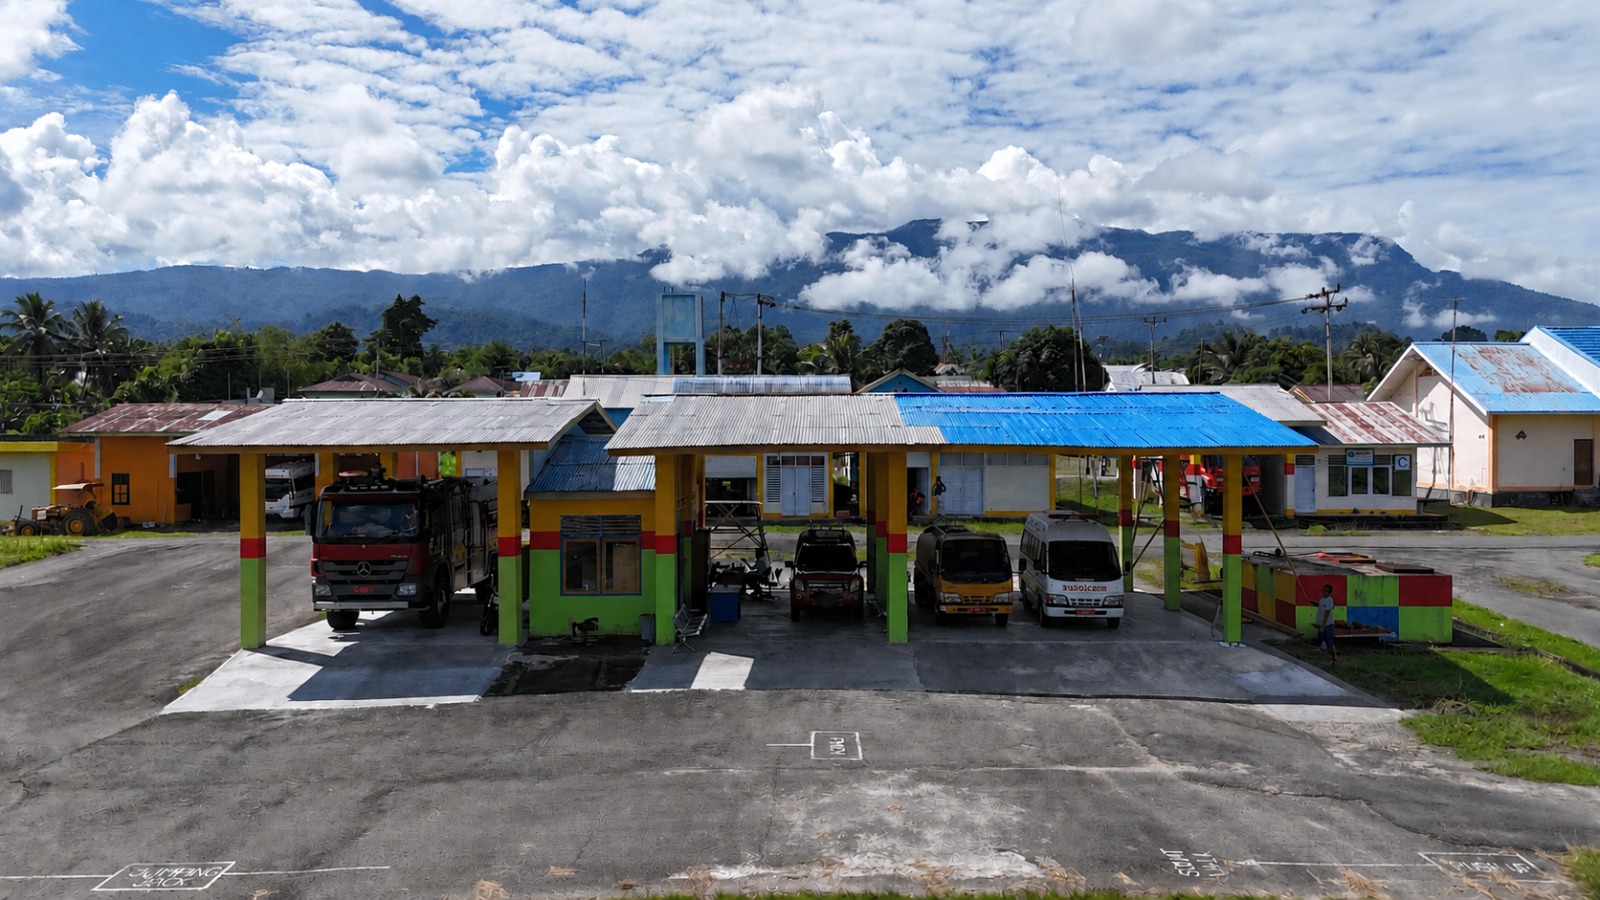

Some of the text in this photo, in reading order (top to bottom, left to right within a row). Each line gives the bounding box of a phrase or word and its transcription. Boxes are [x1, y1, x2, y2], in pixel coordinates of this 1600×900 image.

[1398, 456, 1408, 468] C
[128, 866, 222, 879] JUMPING
[132, 877, 194, 887] JACK
